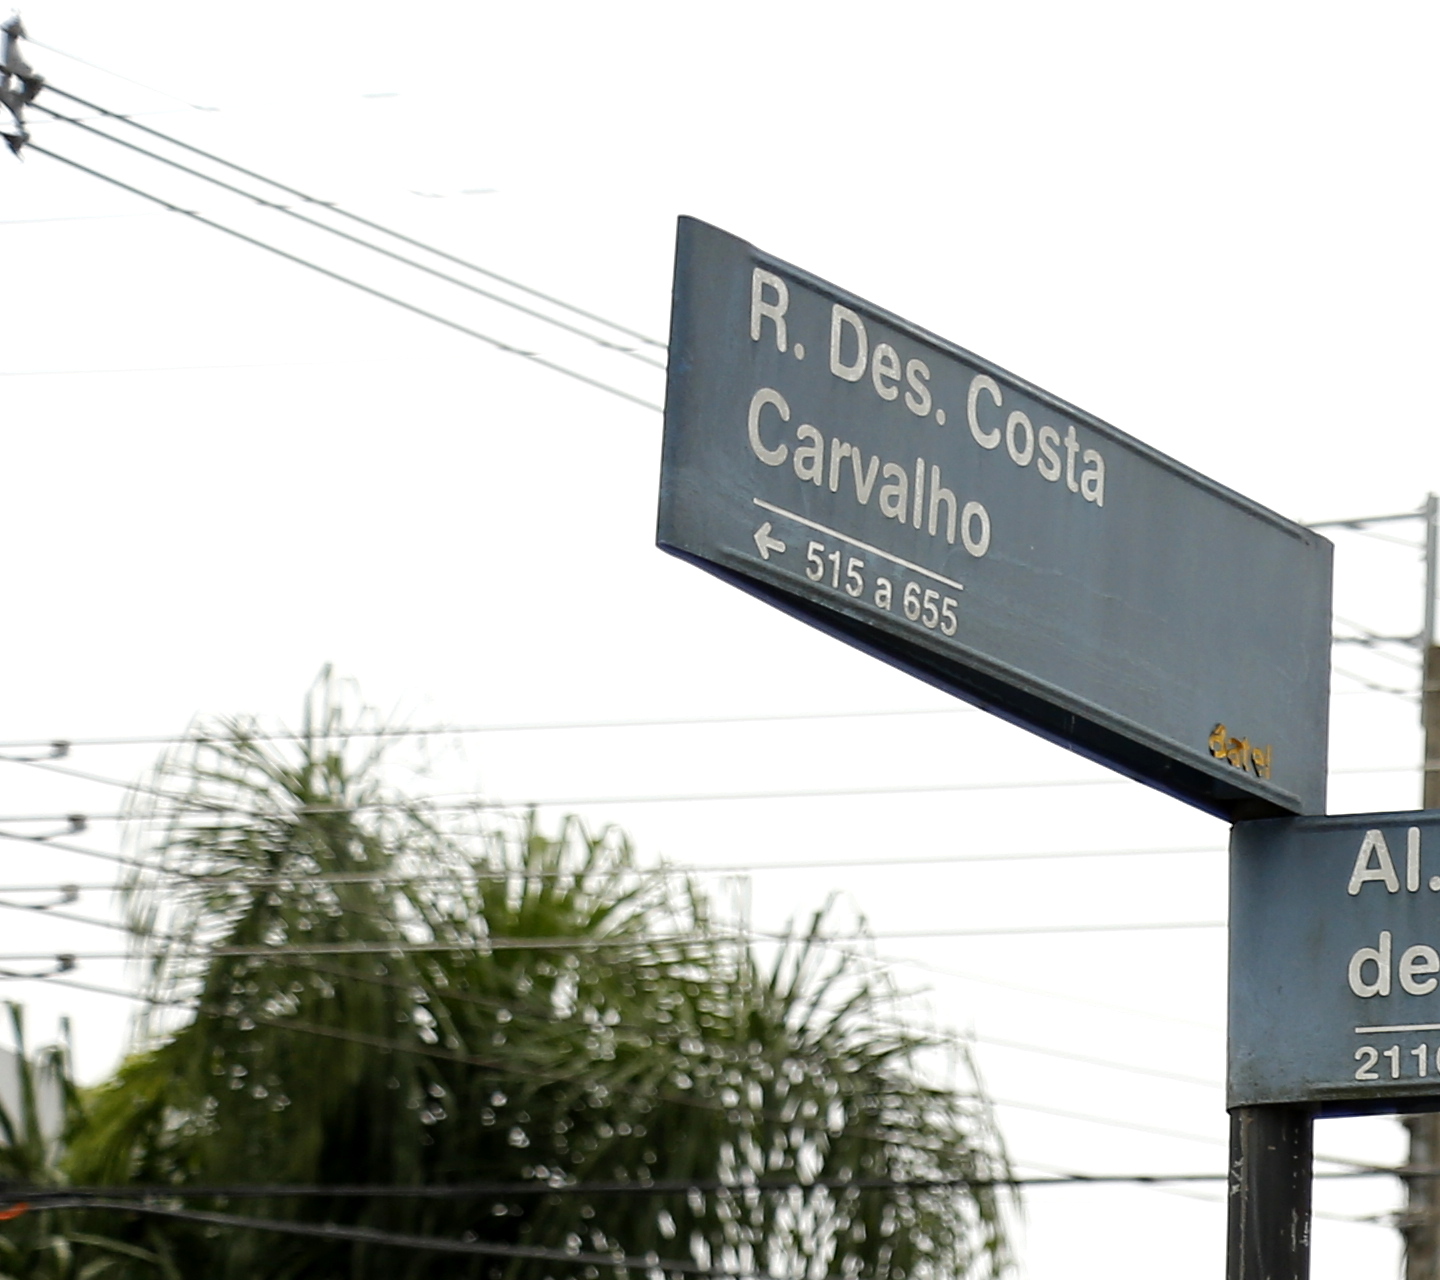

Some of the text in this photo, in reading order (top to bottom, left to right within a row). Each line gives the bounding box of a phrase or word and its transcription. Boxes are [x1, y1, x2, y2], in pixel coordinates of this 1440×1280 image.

[746, 386, 992, 559] Carvalho
[749, 267, 1108, 508] R. Des. Costa
[805, 541, 960, 637] 515 a 655
